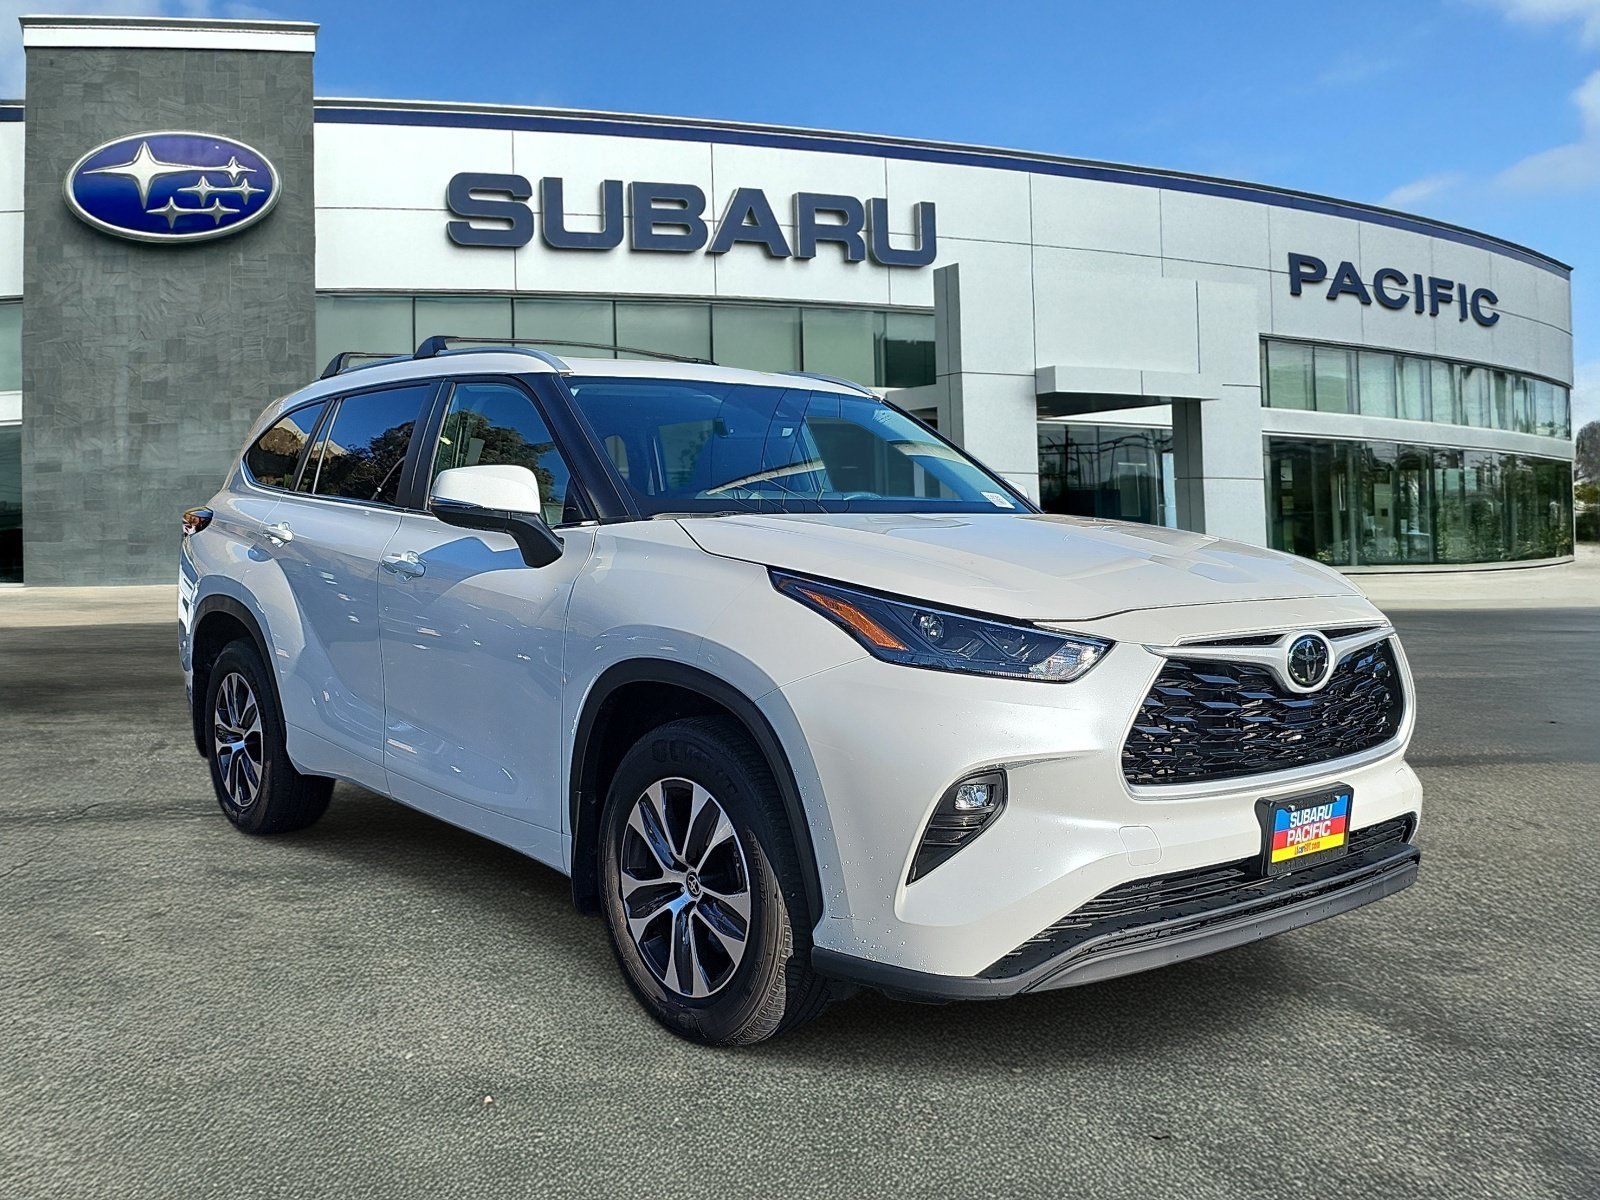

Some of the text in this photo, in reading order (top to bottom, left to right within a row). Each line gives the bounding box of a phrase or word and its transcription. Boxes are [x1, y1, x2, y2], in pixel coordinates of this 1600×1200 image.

[446, 172, 938, 268] SUBARU
[1288, 252, 1501, 327] PACIFIC
[1286, 820, 1332, 847] PACIFIC
[1289, 803, 1333, 828] SUBARU
